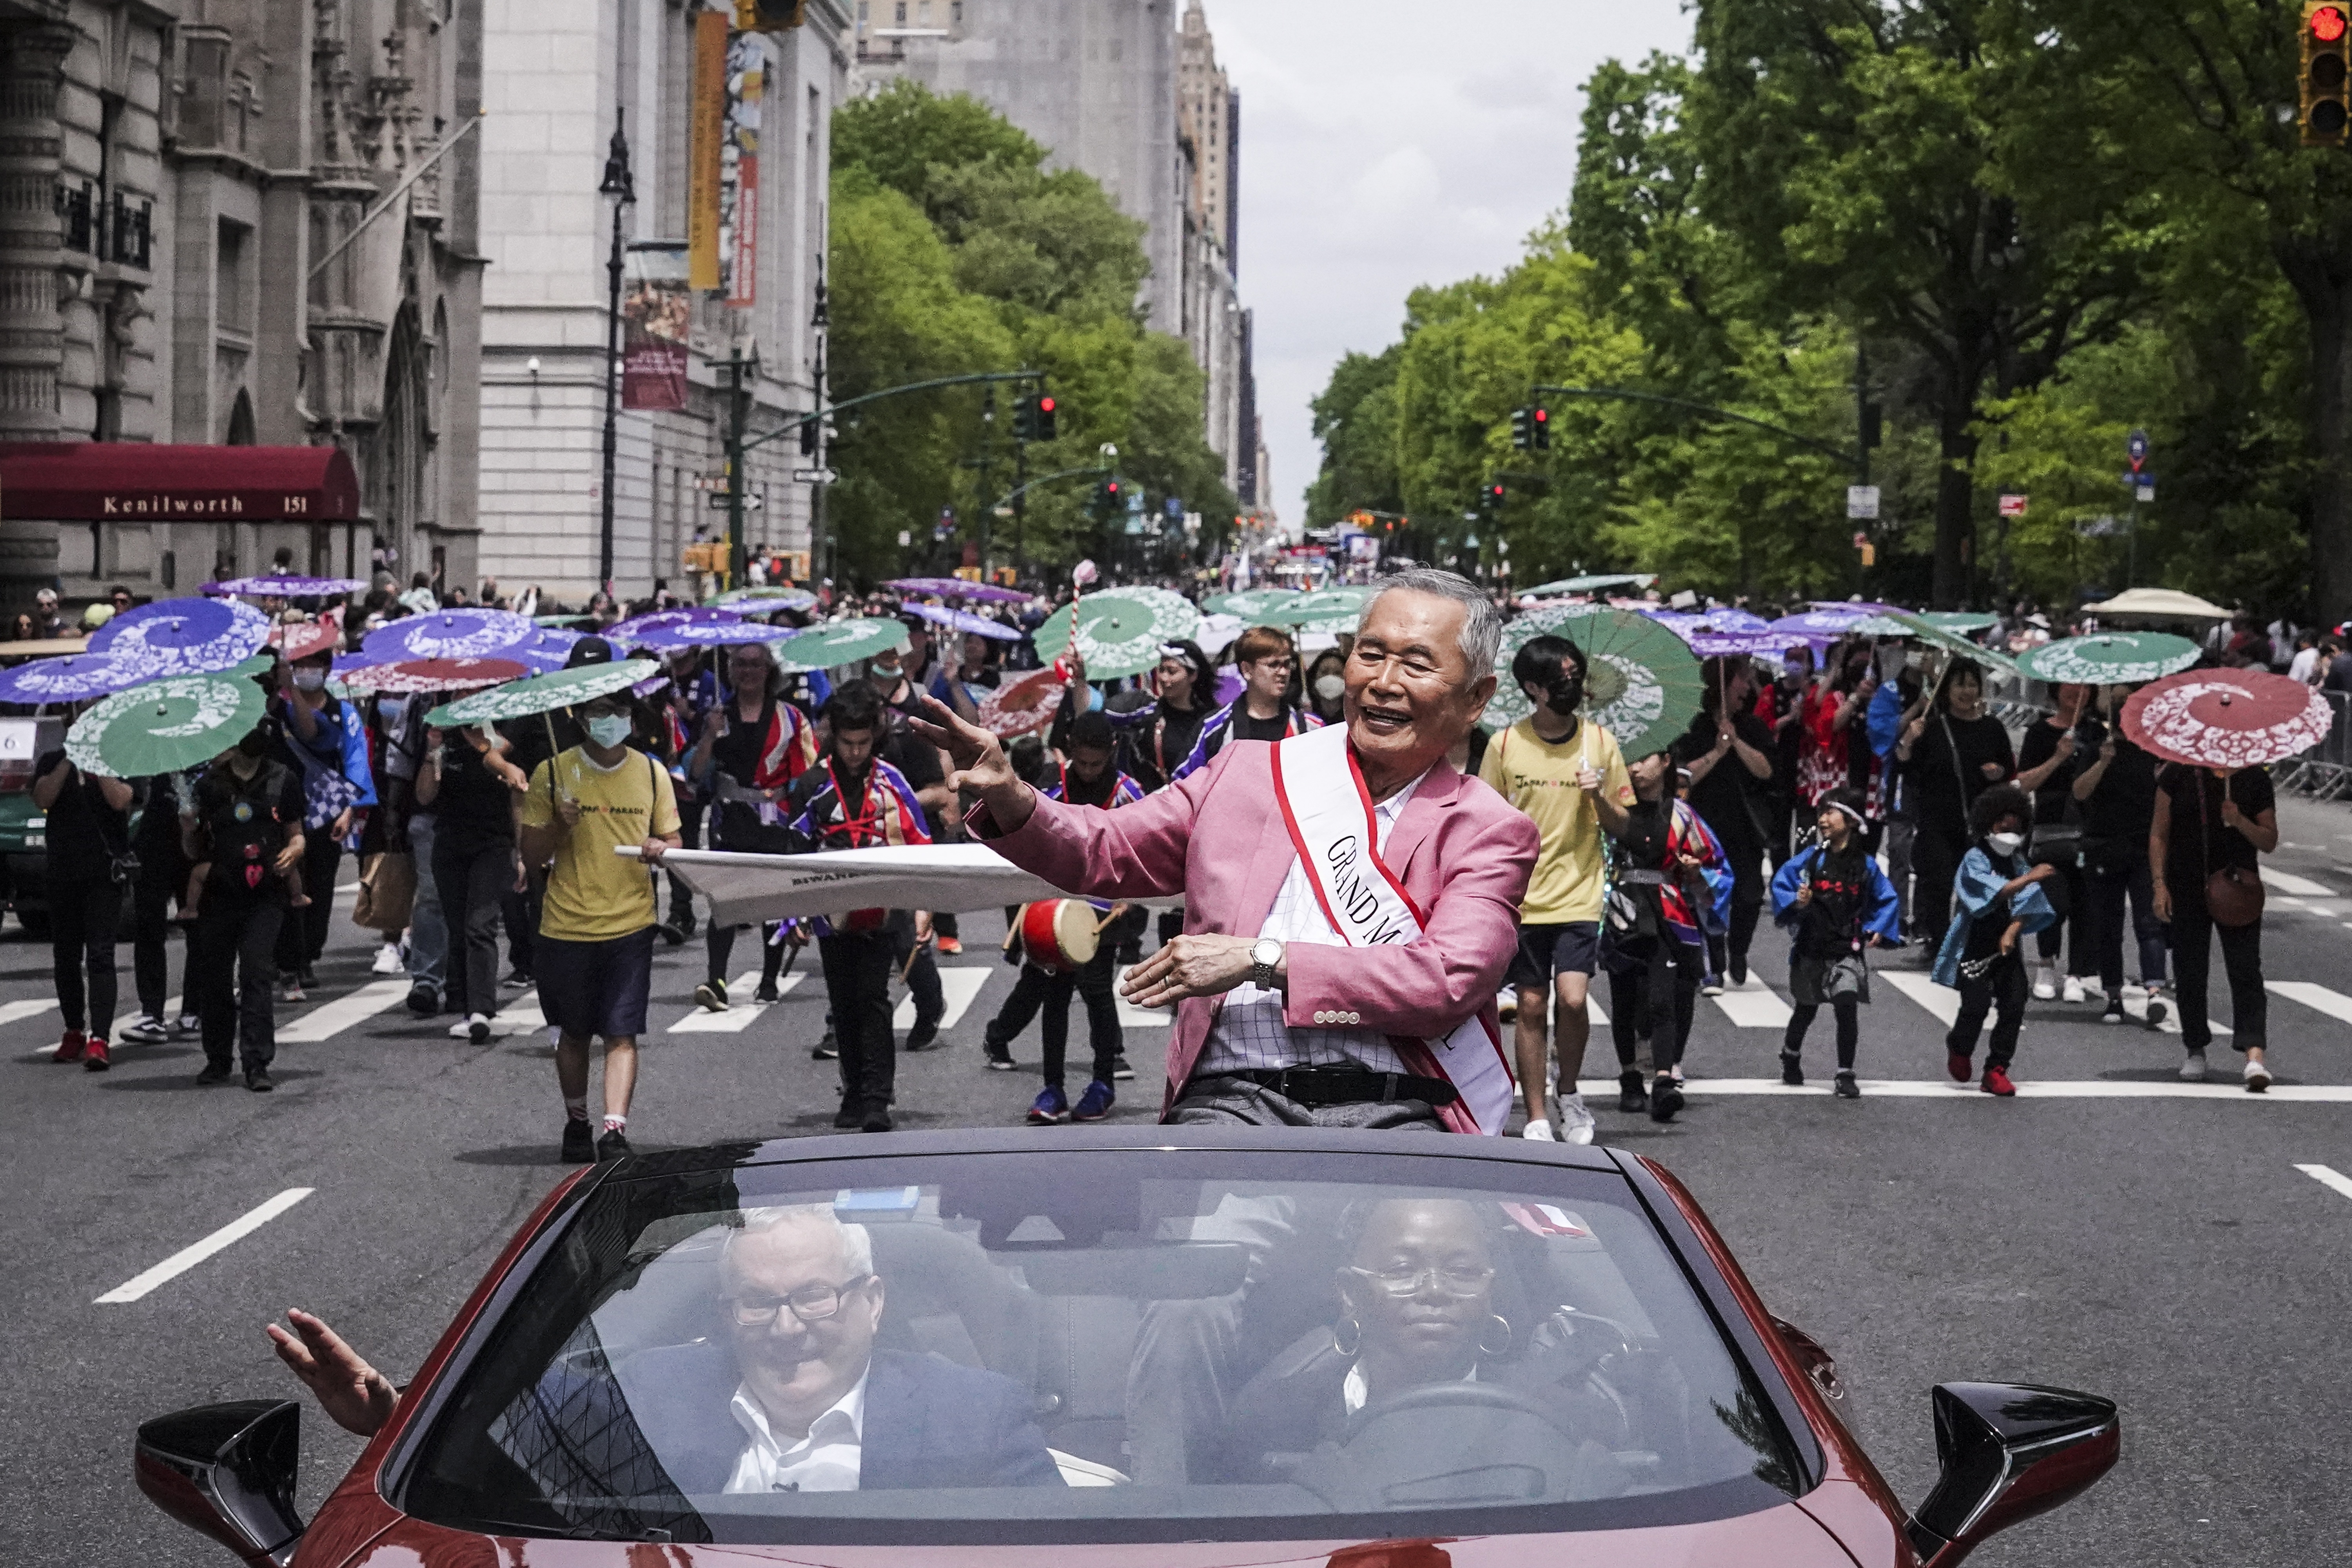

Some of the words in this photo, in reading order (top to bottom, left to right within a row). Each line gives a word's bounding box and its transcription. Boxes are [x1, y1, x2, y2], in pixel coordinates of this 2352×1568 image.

[104, 495, 243, 513] Kenilworth
[284, 496, 307, 514] 151
[4, 733, 15, 750] 6
[1328, 835, 1379, 924] GRAND
